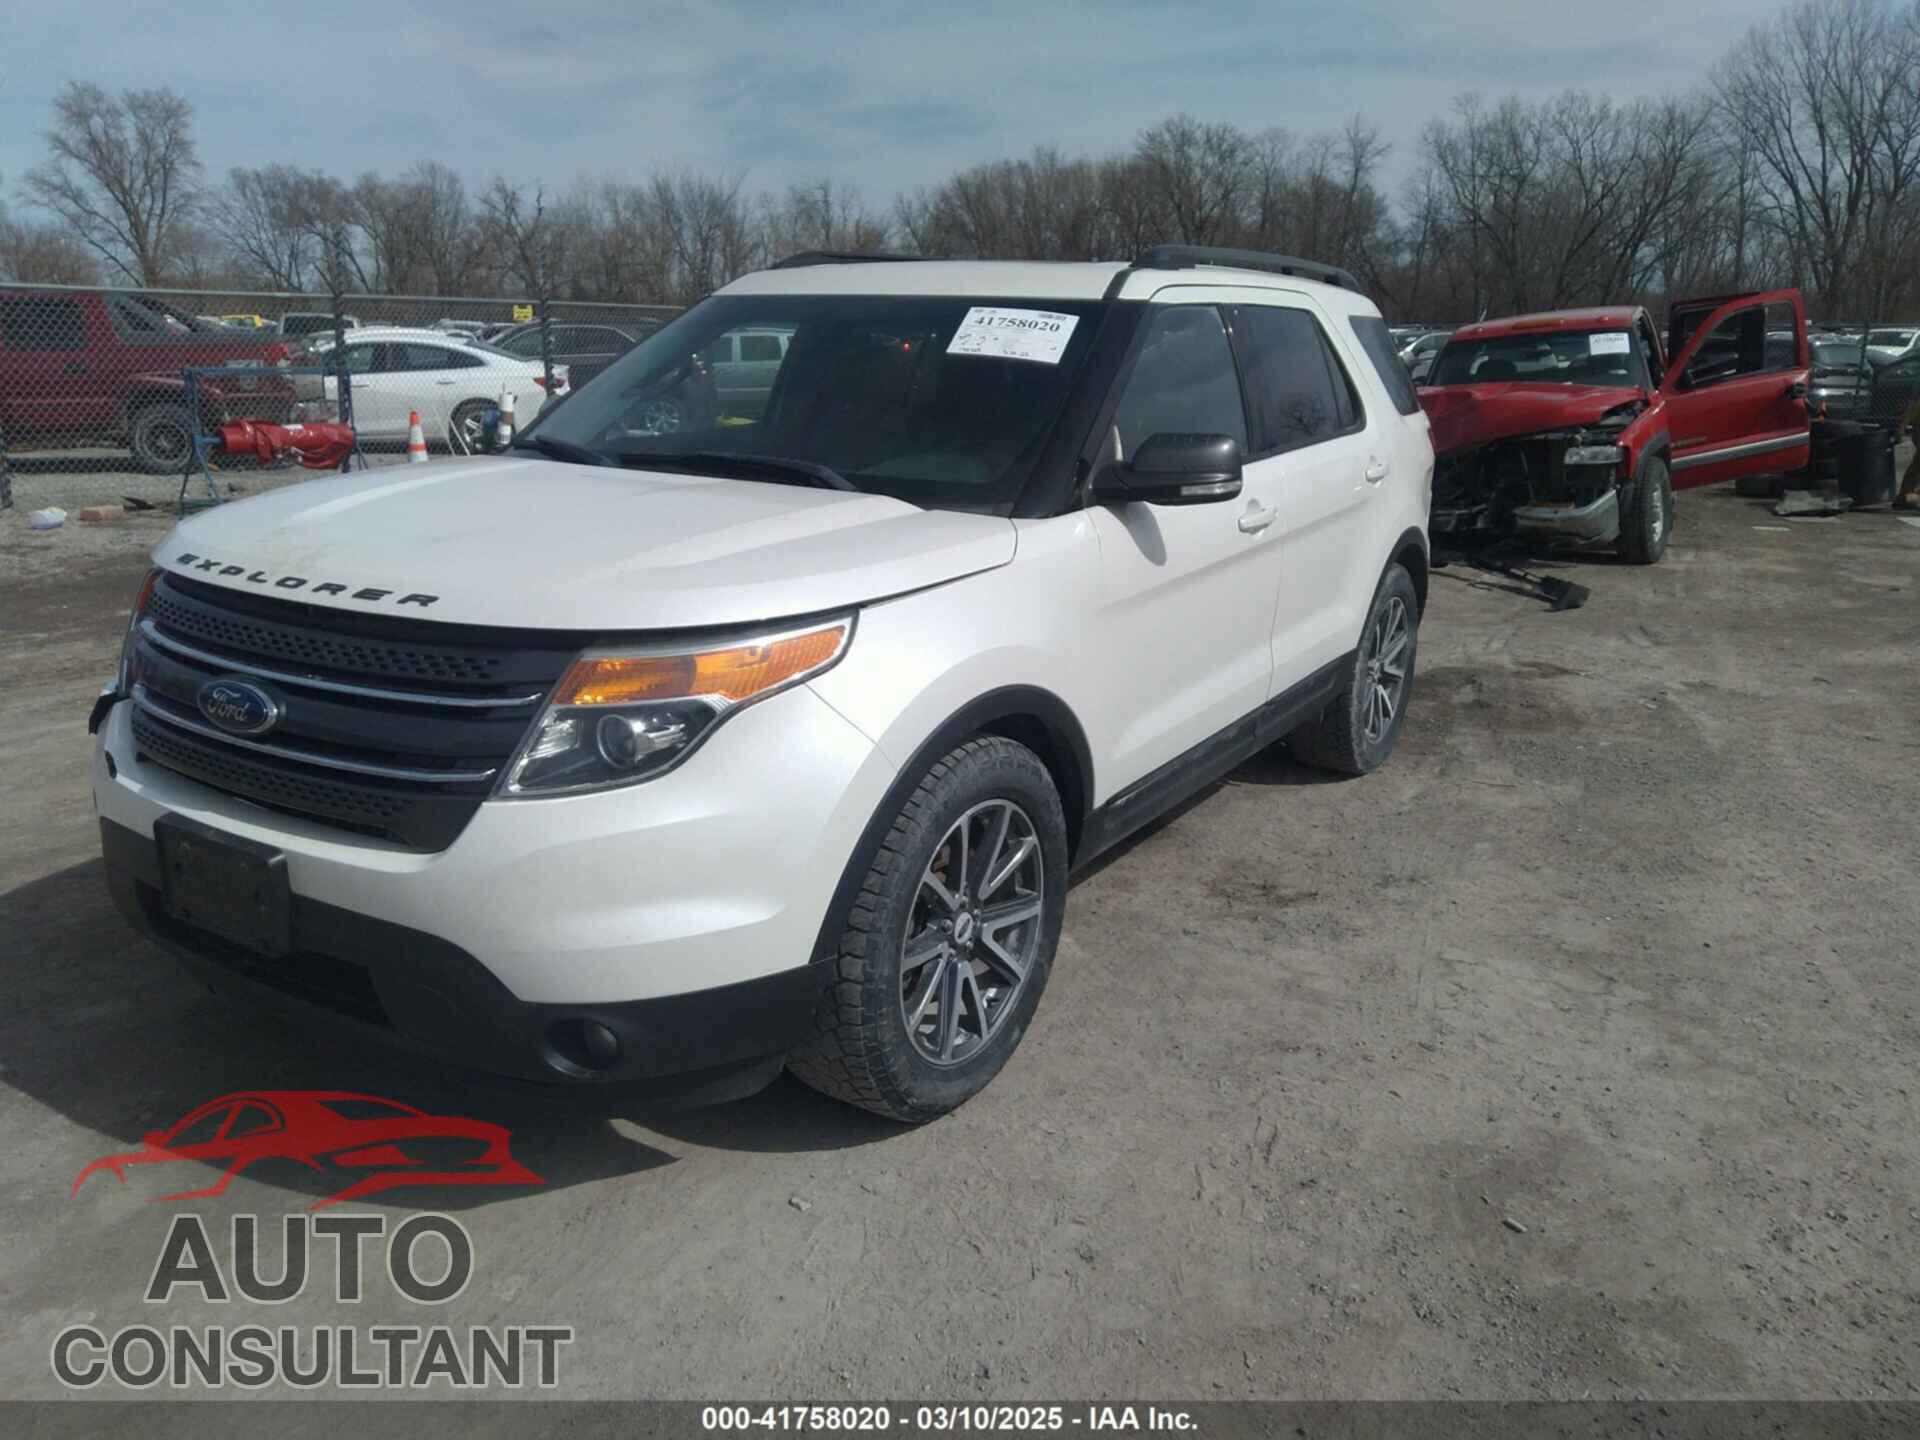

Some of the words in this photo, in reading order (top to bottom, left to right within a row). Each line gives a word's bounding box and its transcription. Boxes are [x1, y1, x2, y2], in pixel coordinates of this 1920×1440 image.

[973, 316, 1061, 333] 41758020
[176, 553, 440, 607] EXPLORER
[207, 687, 251, 722] Ford
